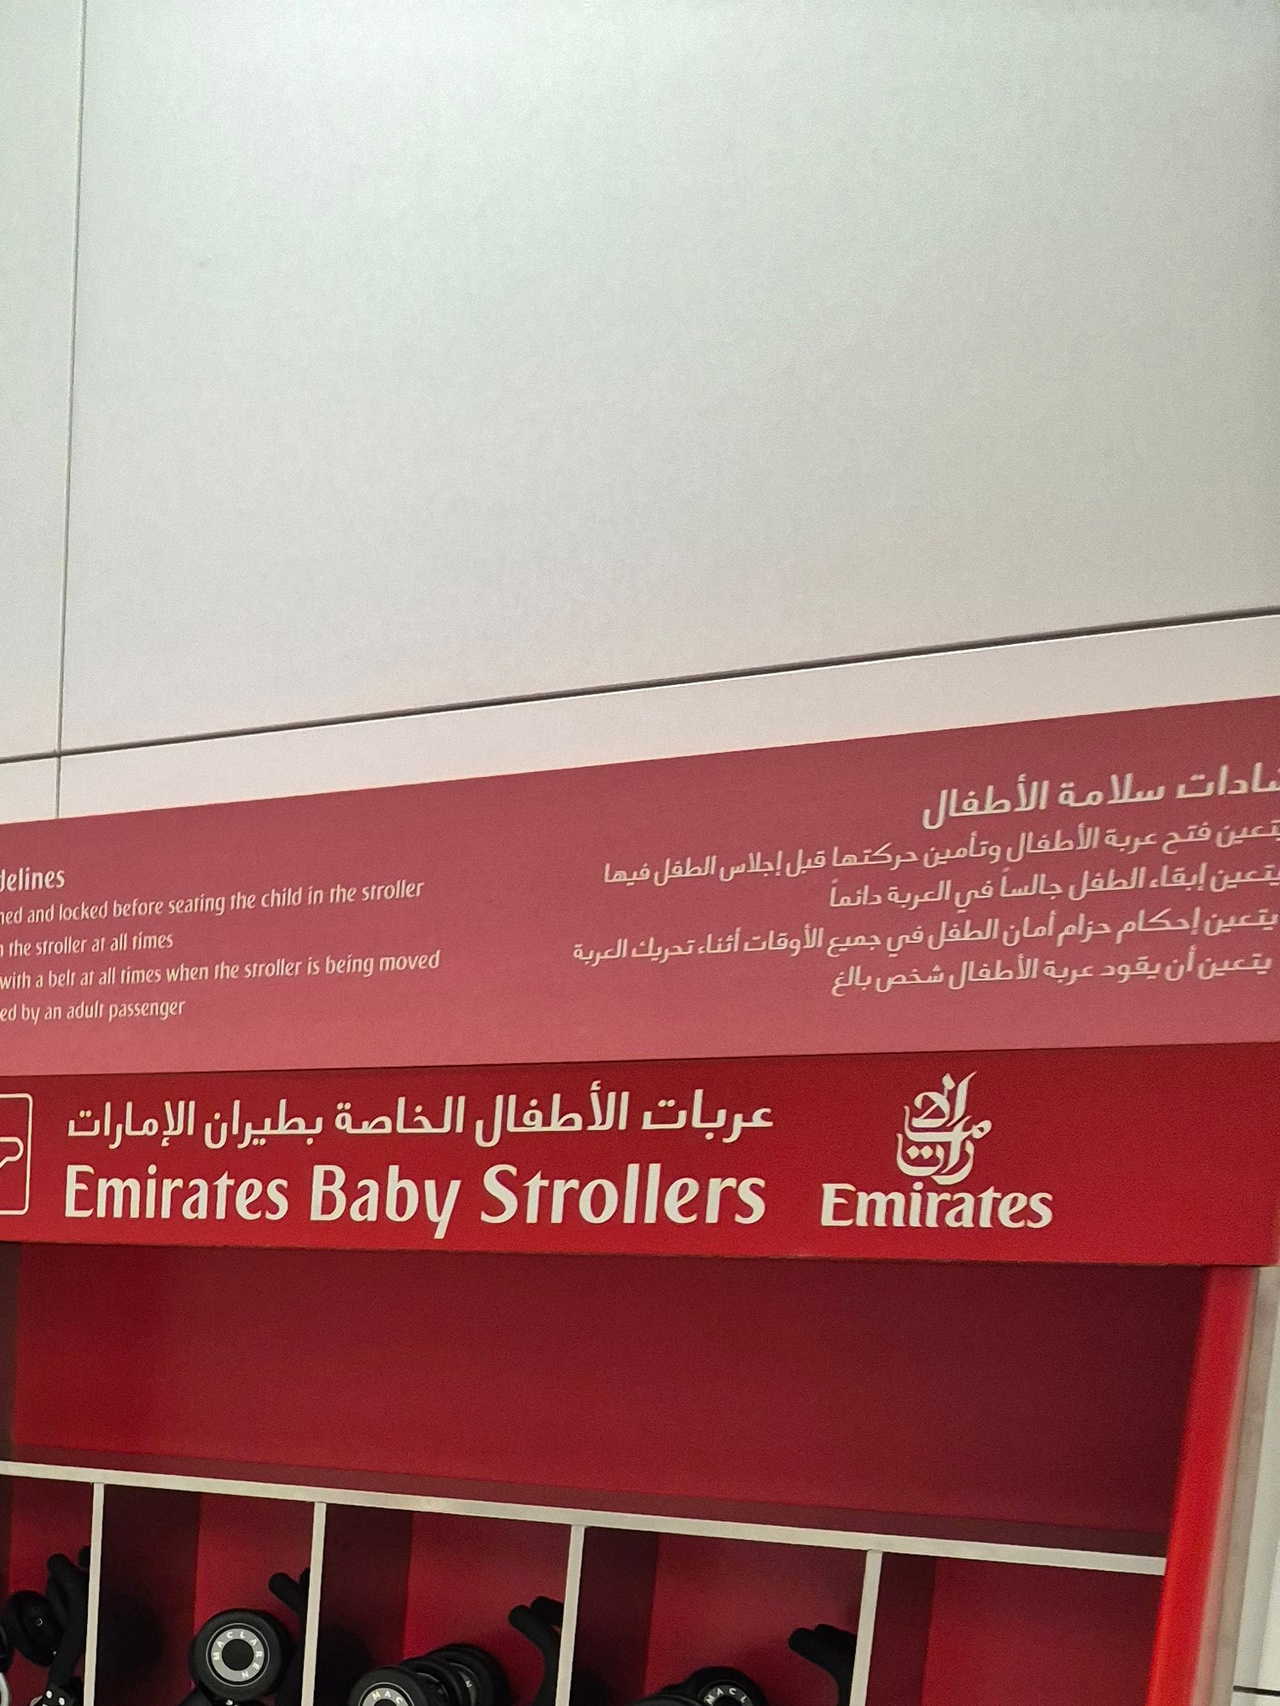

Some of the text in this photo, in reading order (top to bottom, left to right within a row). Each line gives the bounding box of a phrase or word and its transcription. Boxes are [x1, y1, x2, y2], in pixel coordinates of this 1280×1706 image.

[922, 762, 1280, 830] ادات سلامة الأطفال
[604, 818, 1280, 886] تعين فتح عربة الأطفال وتأمين حركتها قبل إجلاس الطفل فيها
[887, 880, 951, 910] العربة
[955, 883, 993, 913] في
[1068, 866, 1147, 901] الطفل
[1149, 861, 1207, 891] إبقاء
[27, 904, 54, 923] and
[59, 901, 108, 920] locked
[113, 899, 163, 917] before
[169, 894, 225, 914] seating
[231, 892, 256, 910] the
[261, 887, 302, 907] child
[308, 886, 323, 904] in
[330, 884, 356, 903] the
[362, 880, 424, 901] stroller
[9, 940, 31, 956] the
[36, 937, 87, 955] stroller
[92, 937, 105, 952] at
[110, 933, 127, 951] all
[133, 932, 173, 950] times
[573, 906, 1279, 967] يتعين إحكام حزام أمان الطفل في جميع الأوقات أثناء تحريك العربة
[0, 972, 31, 990] with
[36, 975, 43, 988] a
[49, 969, 75, 987] belt
[80, 971, 94, 986] at
[99, 967, 115, 985] all
[121, 966, 161, 984] times
[166, 964, 208, 982] when
[215, 961, 239, 979] the
[244, 958, 302, 978] stroller
[307, 957, 320, 975] is
[326, 955, 374, 976] being
[379, 950, 440, 971] moved
[831, 945, 1272, 997] يتعين أن يقود عربة الأطفال شخص بالغ
[22, 1004, 40, 1024] by
[44, 1007, 61, 1019] an
[67, 1001, 104, 1019] adult
[109, 1001, 185, 1022] passenger
[67, 1080, 773, 1149] عربات الأطفال الخاصة بطيران الإمارات
[65, 1163, 766, 1240] Emirates Baby Strollers
[821, 1181, 1053, 1229] Emirates
[213, 1631, 263, 1679] MACLAREN
